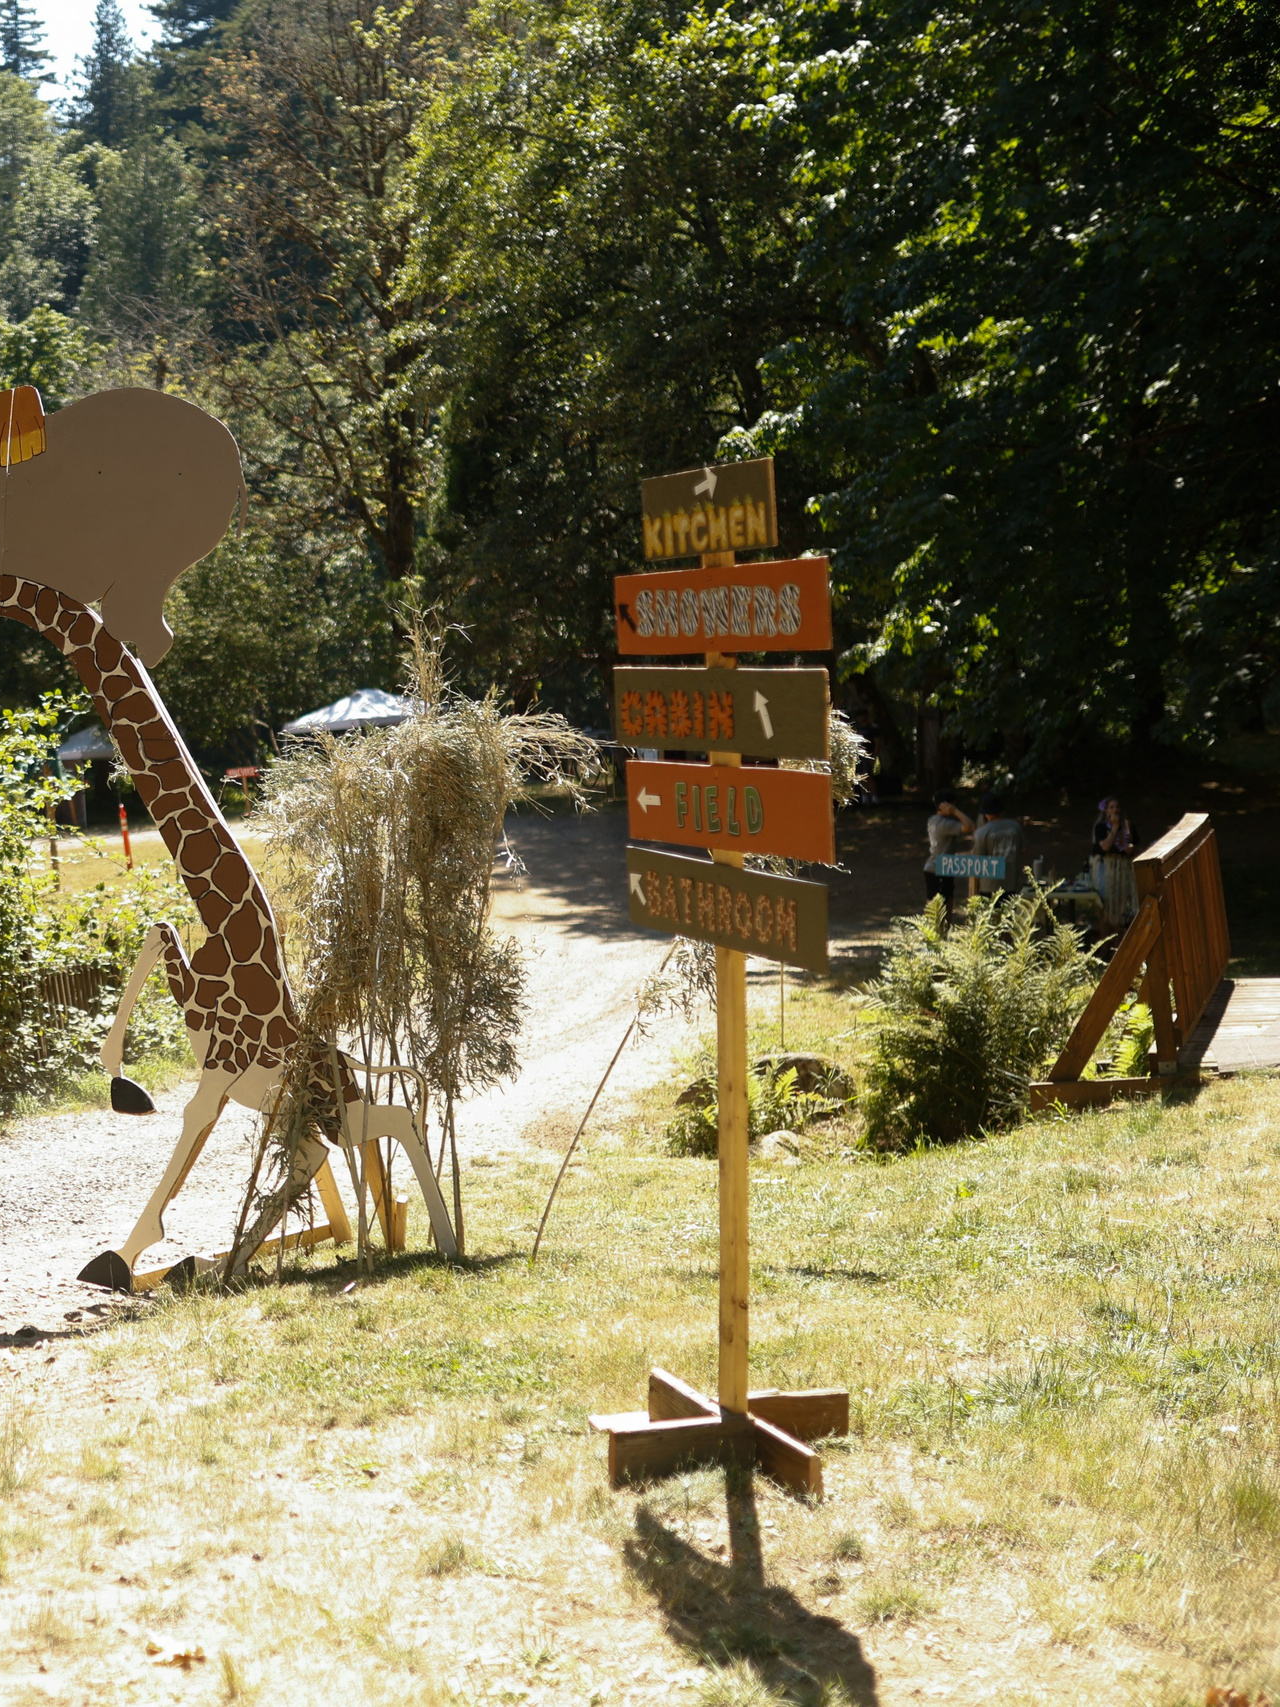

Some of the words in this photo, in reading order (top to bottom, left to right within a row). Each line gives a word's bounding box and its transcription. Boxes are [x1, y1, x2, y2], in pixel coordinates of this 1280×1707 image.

[644, 497, 768, 559] KITCHEN
[636, 584, 801, 638] SHOWERS
[621, 690, 734, 739] CABIN
[675, 782, 763, 835] FIELD
[941, 856, 999, 877] PASSPORT
[646, 870, 797, 952] BATHROOM
